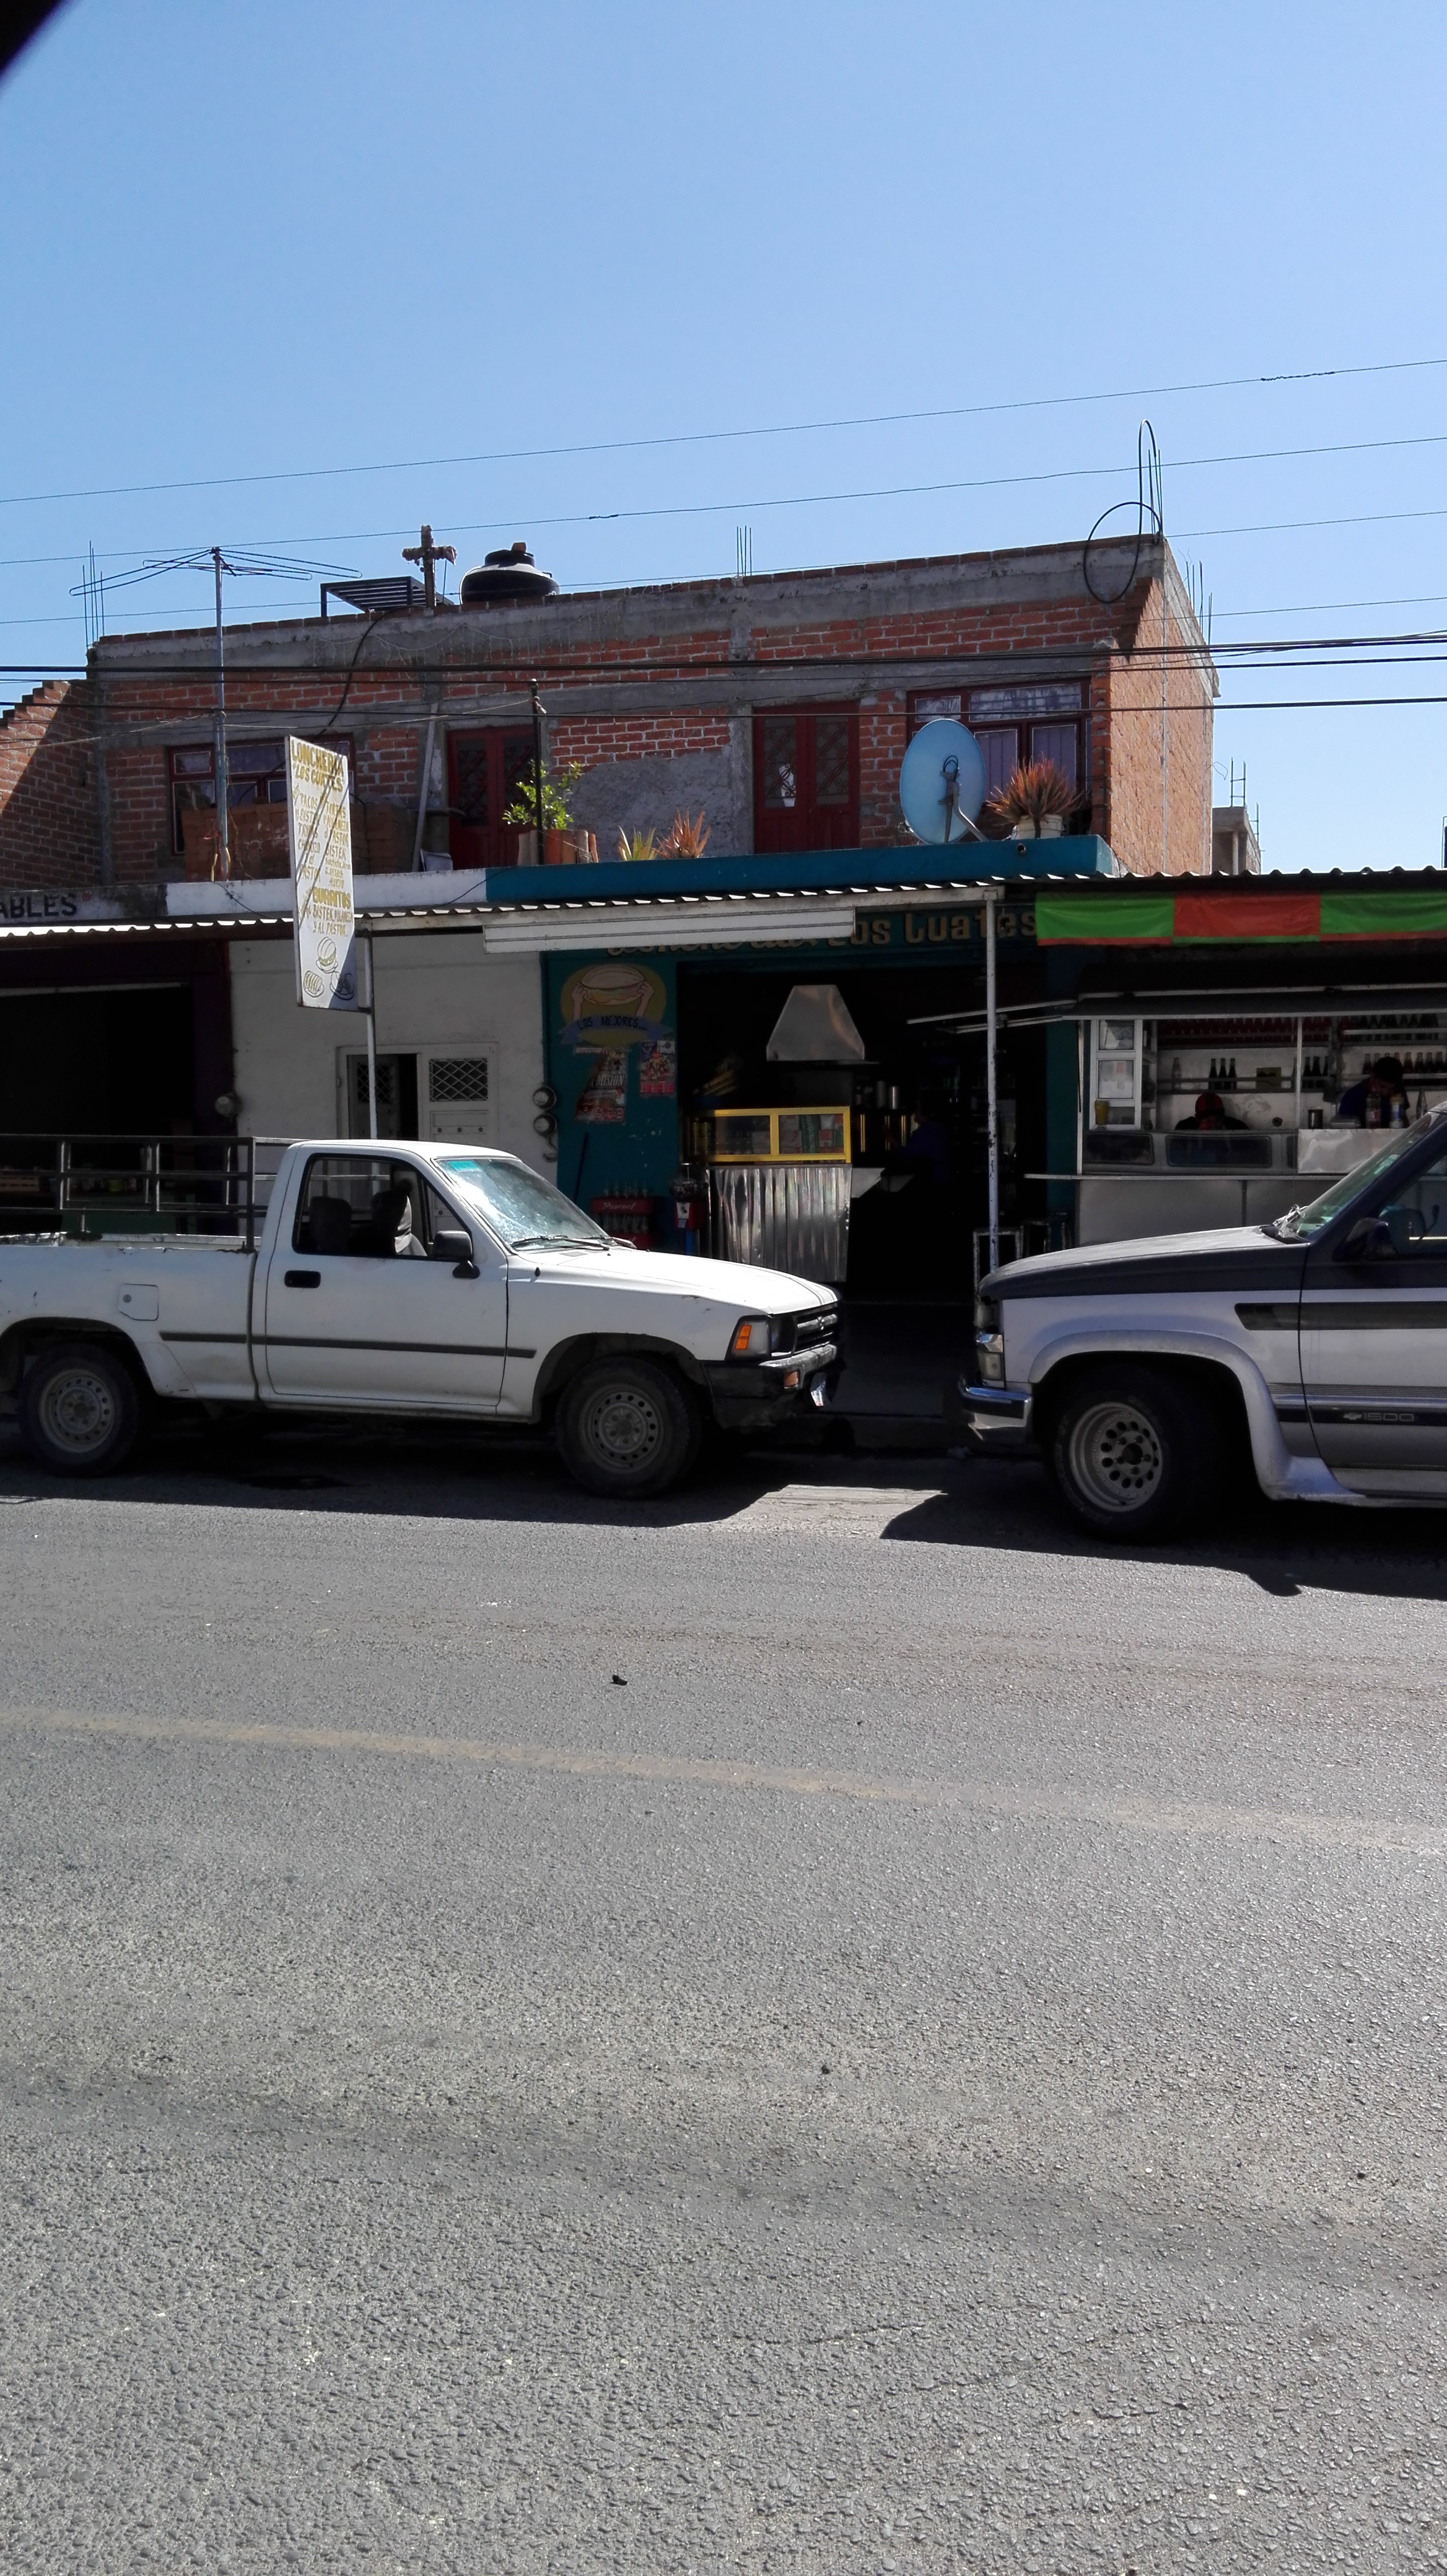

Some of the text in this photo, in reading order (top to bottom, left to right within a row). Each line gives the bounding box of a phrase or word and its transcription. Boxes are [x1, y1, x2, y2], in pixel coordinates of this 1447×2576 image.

[291, 740, 344, 778] LONCHERIA
[313, 886, 351, 909] BURRITOS
[828, 919, 891, 946] os
[577, 1017, 593, 1030] LOS
[1363, 1412, 1414, 1421] 1500
